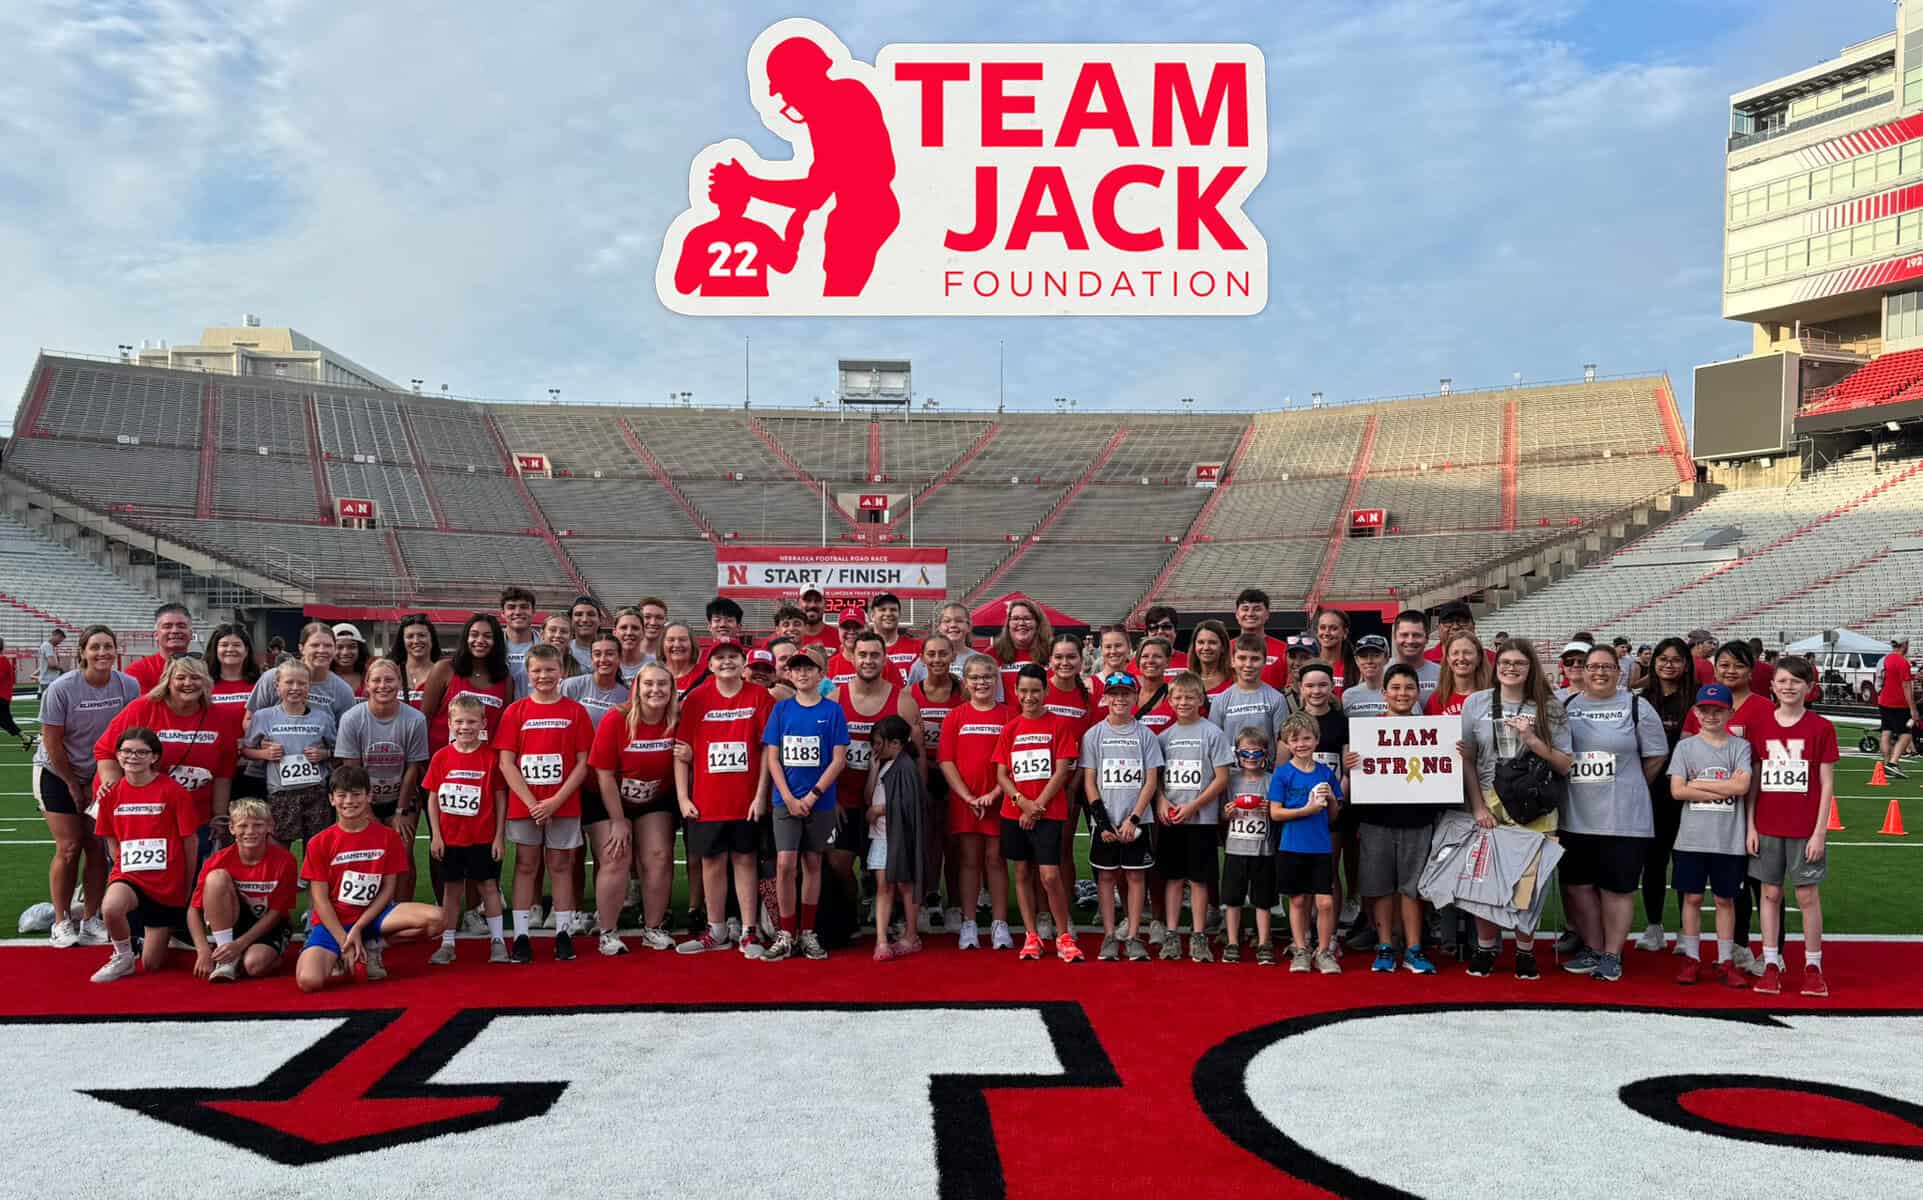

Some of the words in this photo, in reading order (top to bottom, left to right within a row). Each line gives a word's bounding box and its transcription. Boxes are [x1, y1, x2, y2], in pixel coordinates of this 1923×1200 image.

[727, 565, 748, 585] N
[764, 568, 822, 584] START
[839, 568, 901, 584] FINISH
[1706, 687, 1718, 696] C
[1377, 728, 1438, 747] LIAM
[783, 746, 821, 762] 1183
[1765, 739, 1805, 760] N
[709, 751, 748, 768] 1214
[1013, 758, 1050, 775] 6152
[281, 762, 320, 779] 6285
[522, 763, 563, 780] 1155
[1103, 769, 1143, 784] 1164
[1166, 769, 1201, 785] 1160
[1570, 761, 1617, 778] 1001
[1762, 770, 1807, 787] 1184
[440, 792, 480, 811] 1156
[1231, 819, 1266, 834] 1162
[122, 848, 166, 867] 1293
[343, 880, 378, 901] 928
